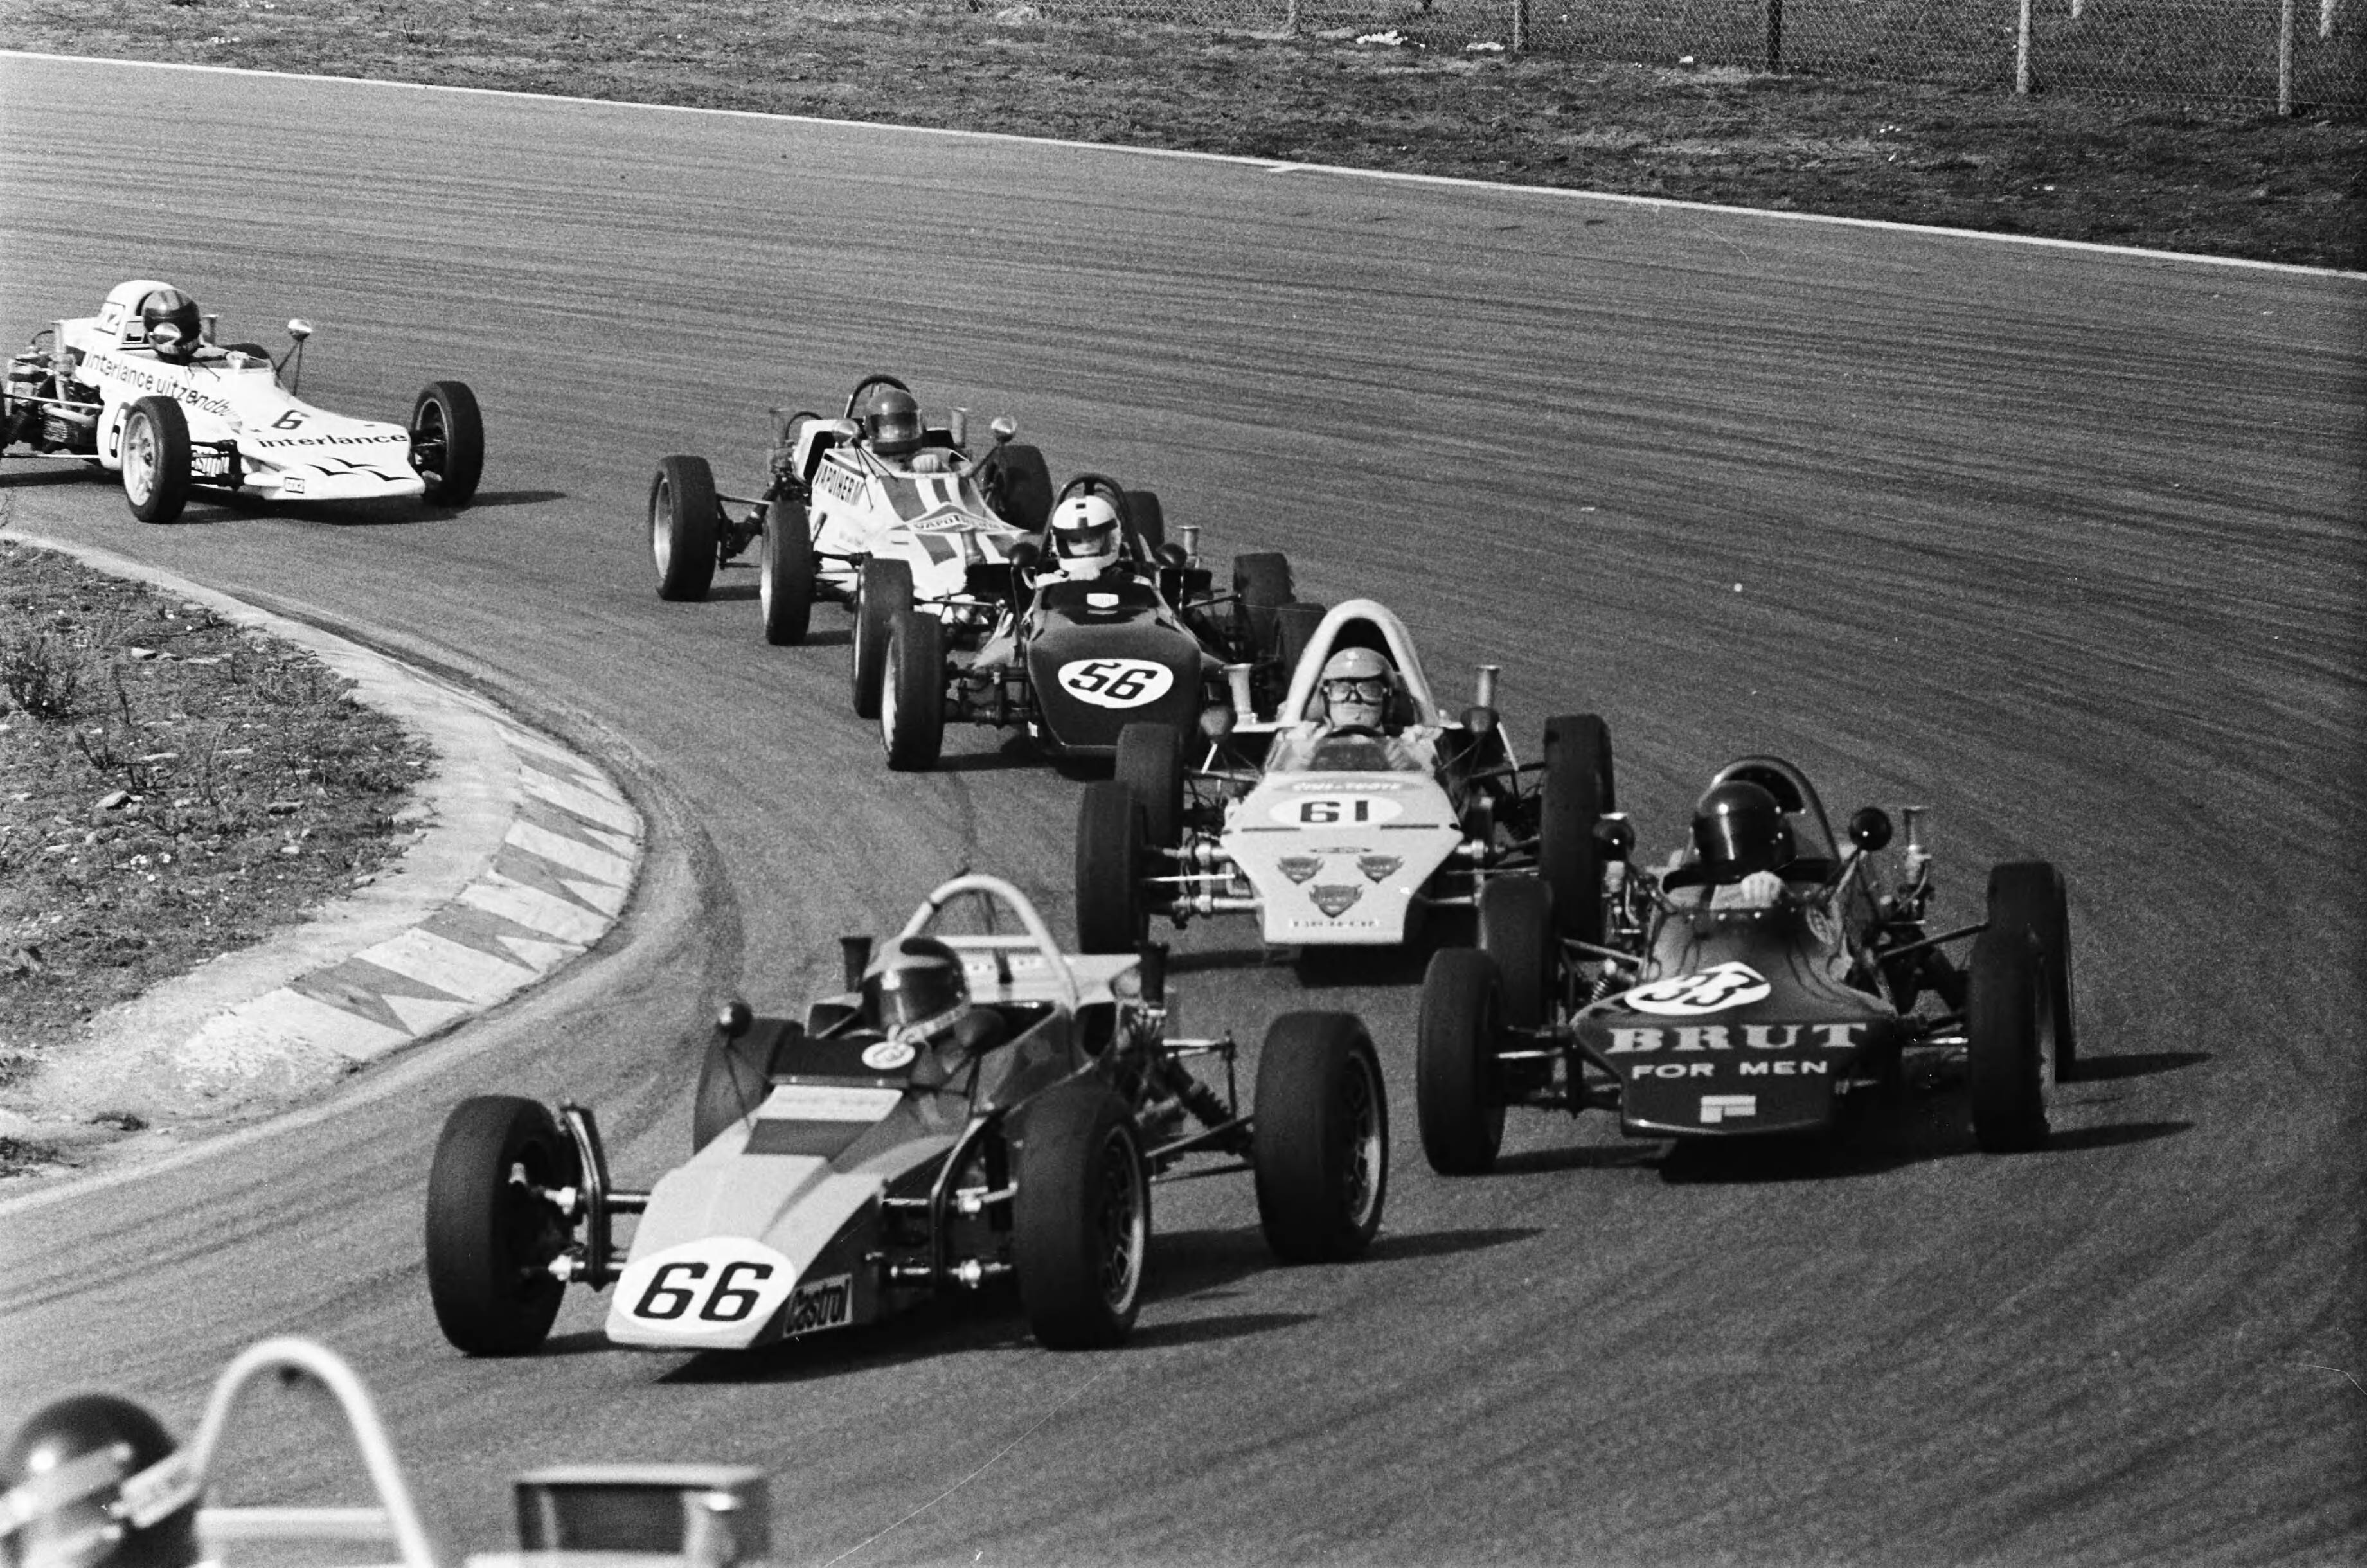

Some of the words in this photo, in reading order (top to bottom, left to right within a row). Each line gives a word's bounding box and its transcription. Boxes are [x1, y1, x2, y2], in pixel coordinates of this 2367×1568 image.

[85, 353, 154, 391] interlance
[271, 409, 310, 429] 6
[258, 434, 409, 448] interlance
[1068, 663, 1158, 700] 56
[1300, 800, 1368, 823] 61
[1638, 971, 1767, 1006] 33
[1606, 1023, 1866, 1053] BRUT
[1632, 1064, 1715, 1079] FOR
[1739, 1061, 1828, 1076] MEN
[633, 1261, 773, 1321] 66
